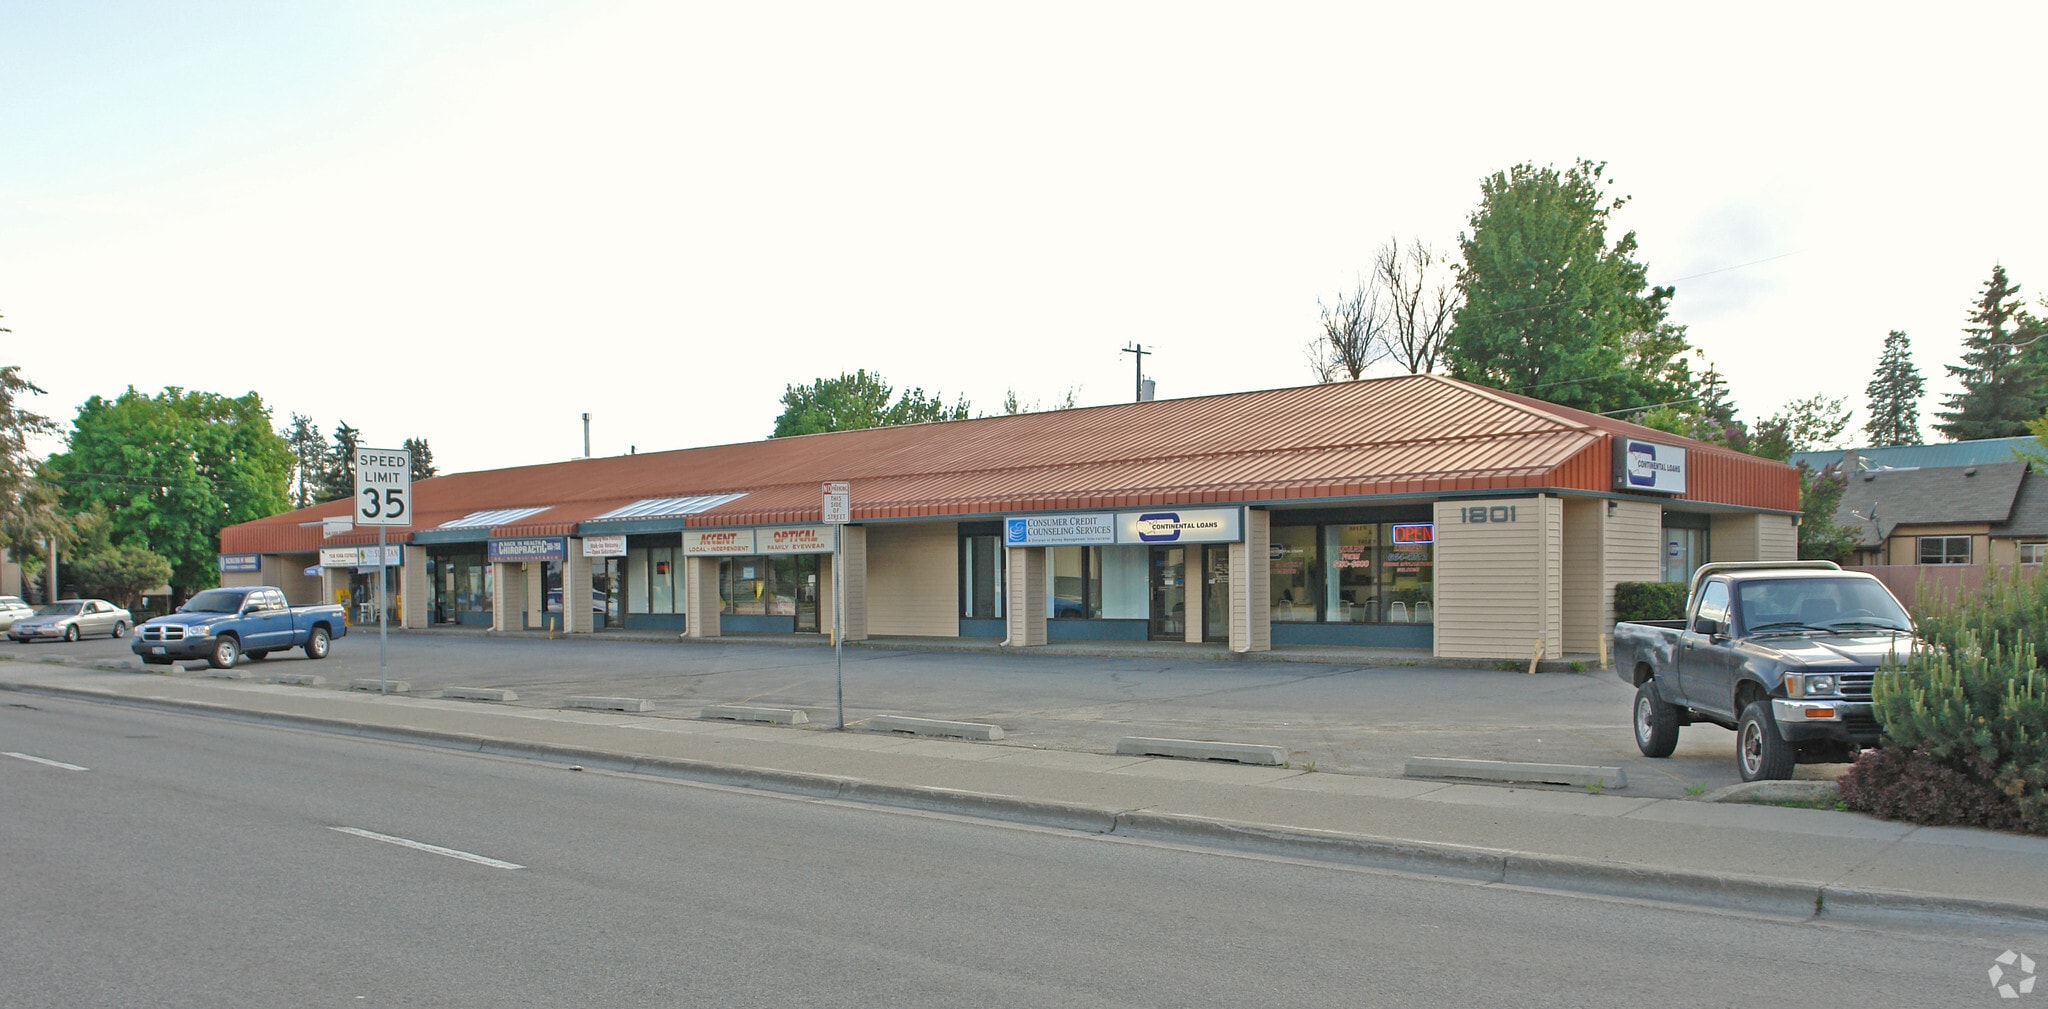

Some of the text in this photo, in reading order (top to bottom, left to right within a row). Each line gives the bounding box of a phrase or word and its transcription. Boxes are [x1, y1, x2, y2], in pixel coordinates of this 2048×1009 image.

[360, 454, 405, 467] SPEED
[1637, 459, 1680, 473] CONTINENTAL LOANS
[365, 471, 400, 483] LIMIT
[824, 484, 832, 493] NO
[361, 487, 405, 518] 35
[1461, 505, 1516, 523] 1801
[1028, 516, 1097, 527] CONSUMER CREDIT
[1152, 521, 1218, 530] CONTINENTAL LOANS
[773, 529, 818, 543] OPTICAL
[1028, 525, 1111, 536] COUNSELING SERVICES
[1394, 526, 1433, 542] OPEN
[700, 532, 737, 545] ACCENT
[498, 540, 547, 555] CHIROPRACTIC
